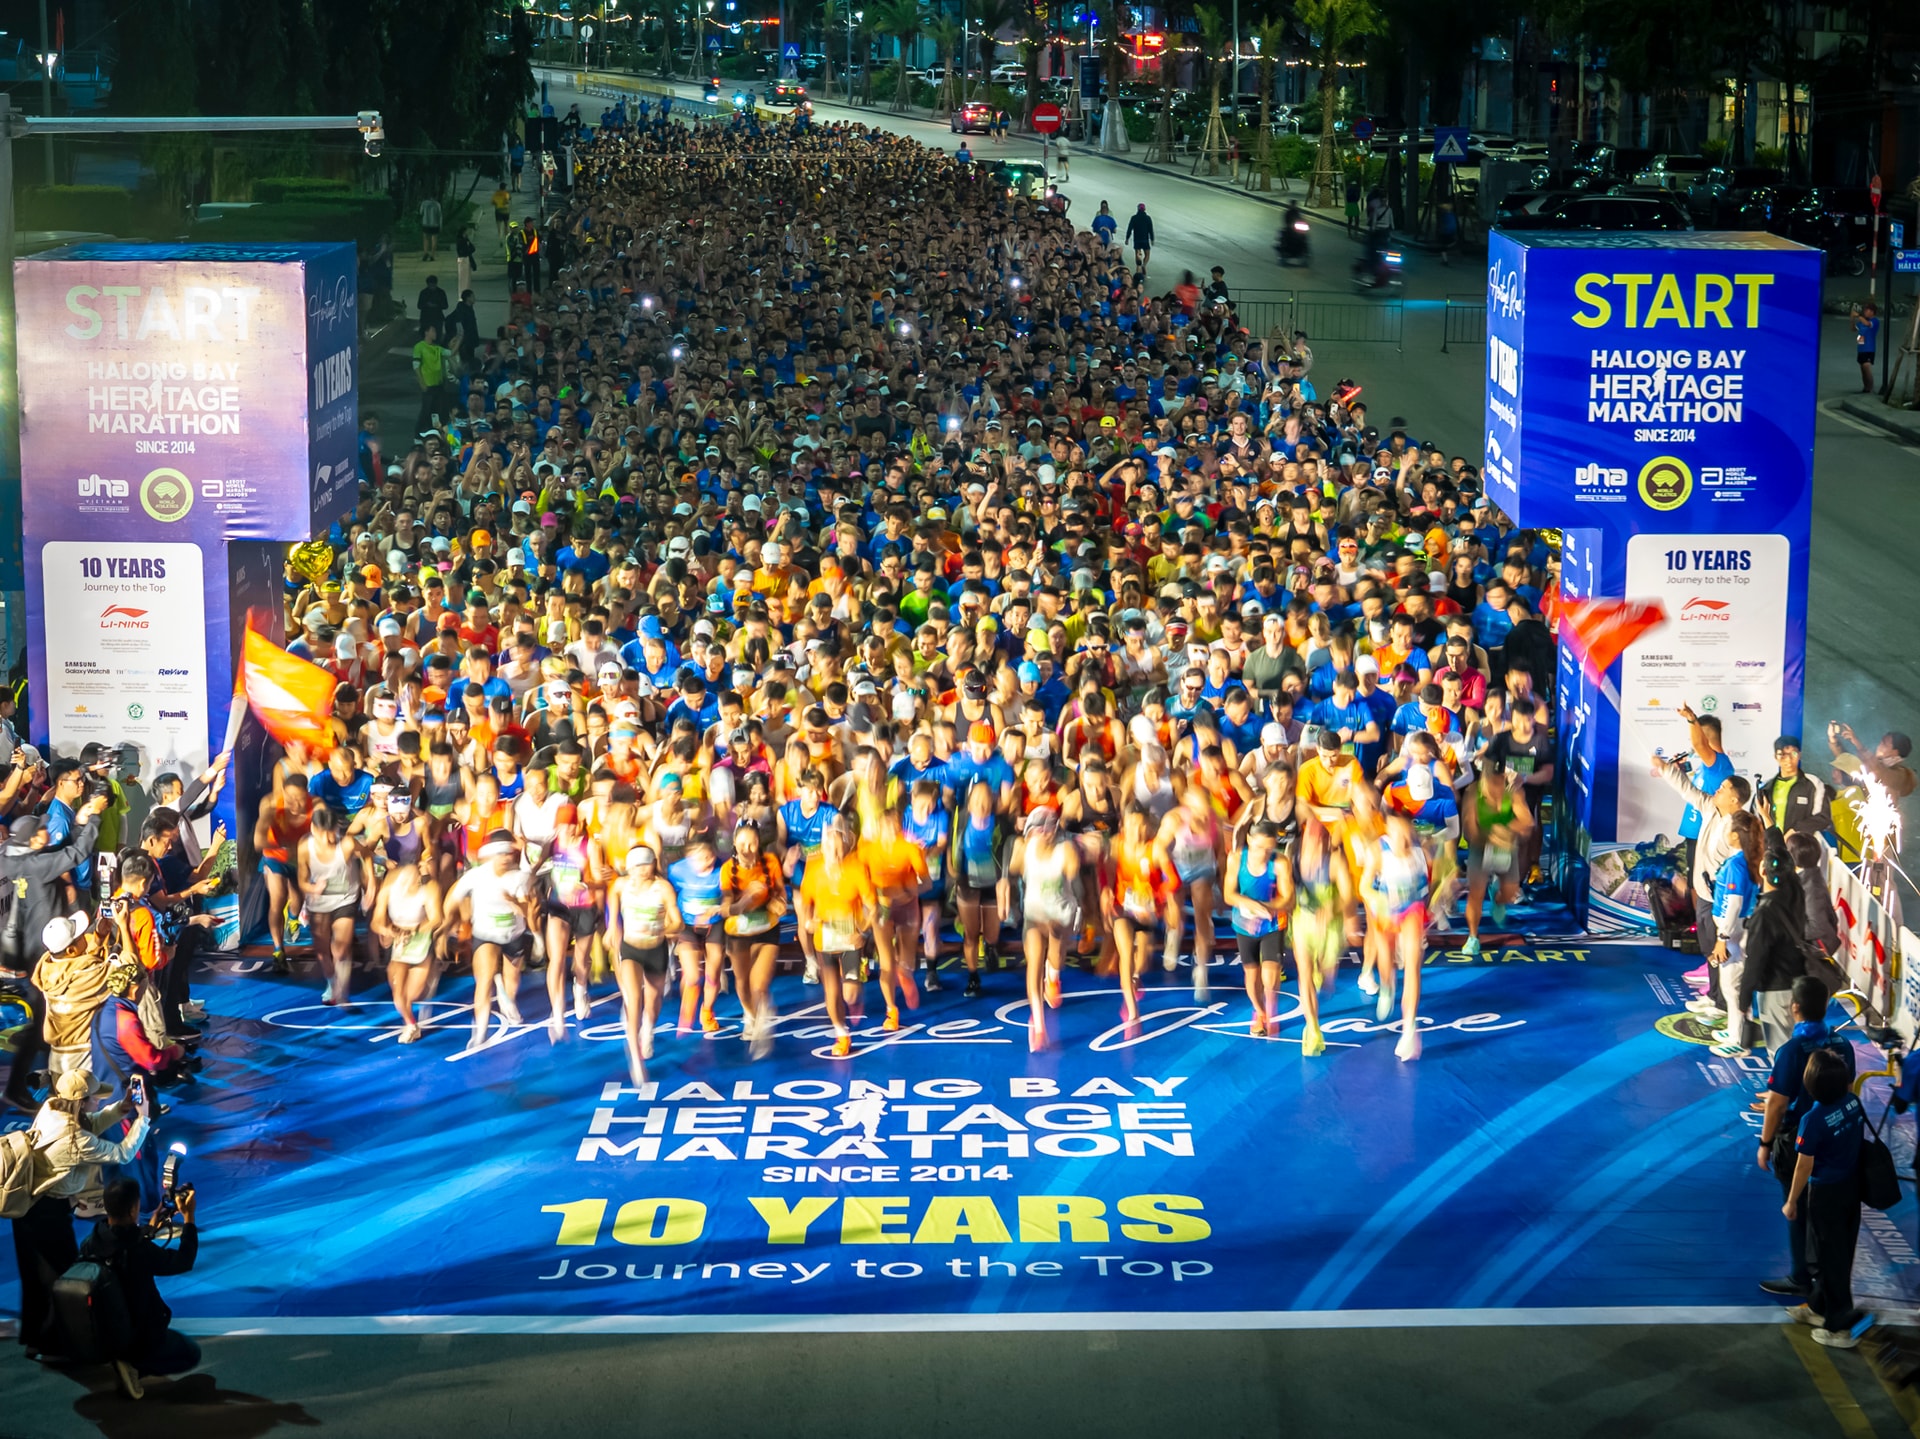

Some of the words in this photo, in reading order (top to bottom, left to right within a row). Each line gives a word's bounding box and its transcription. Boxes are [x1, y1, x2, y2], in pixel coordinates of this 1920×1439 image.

[1571, 272, 1775, 329] START
[64, 285, 261, 342] START
[1590, 350, 1692, 369] HALONG
[1697, 350, 1747, 369] BAY
[87, 362, 187, 381] HALONG
[192, 362, 240, 381] BAY
[313, 360, 323, 411] 10
[325, 346, 352, 404] YEARS
[1589, 374, 1744, 400] HERITAGE
[88, 386, 240, 412] HERITAGE
[1588, 401, 1743, 423] MARATHON
[88, 413, 240, 435] MARATHON
[1634, 429, 1669, 442] SINCE
[1670, 429, 1696, 442] 2014
[135, 440, 169, 454] SINCE
[170, 440, 196, 454] 2014
[80, 557, 102, 578] 10
[105, 557, 166, 579] YEARS
[1665, 550, 1687, 570] 10
[1691, 549, 1752, 571] YEARS
[83, 582, 119, 593] Journey
[120, 583, 131, 592] to
[133, 583, 148, 592] the
[149, 583, 166, 594] Top
[1666, 575, 1703, 586] Journey
[1704, 576, 1715, 585] to
[1716, 575, 1732, 585] the
[1732, 575, 1751, 586] Top
[100, 621, 149, 629] LI-NING
[1680, 613, 1731, 621] LI-NING
[64, 668, 86, 676] Galaxy
[86, 667, 110, 675] Watch8
[1641, 661, 1663, 669] Galaxy
[158, 710, 188, 718] Vinamilk
[1732, 702, 1762, 710] Vinamilk
[600, 1079, 984, 1101] HALONG
[1009, 1075, 1189, 1098] BAY
[587, 1102, 1193, 1136] HERITAGE
[575, 1132, 1196, 1162] MARATHON
[762, 1165, 902, 1183] SINCE
[909, 1164, 1014, 1182] 2014
[540, 1196, 706, 1247] 10
[747, 1193, 1213, 1246] YEARS
[538, 1257, 831, 1284] Journey
[850, 1257, 924, 1279] to
[945, 1255, 1064, 1278] the
[1079, 1254, 1215, 1282] Top
